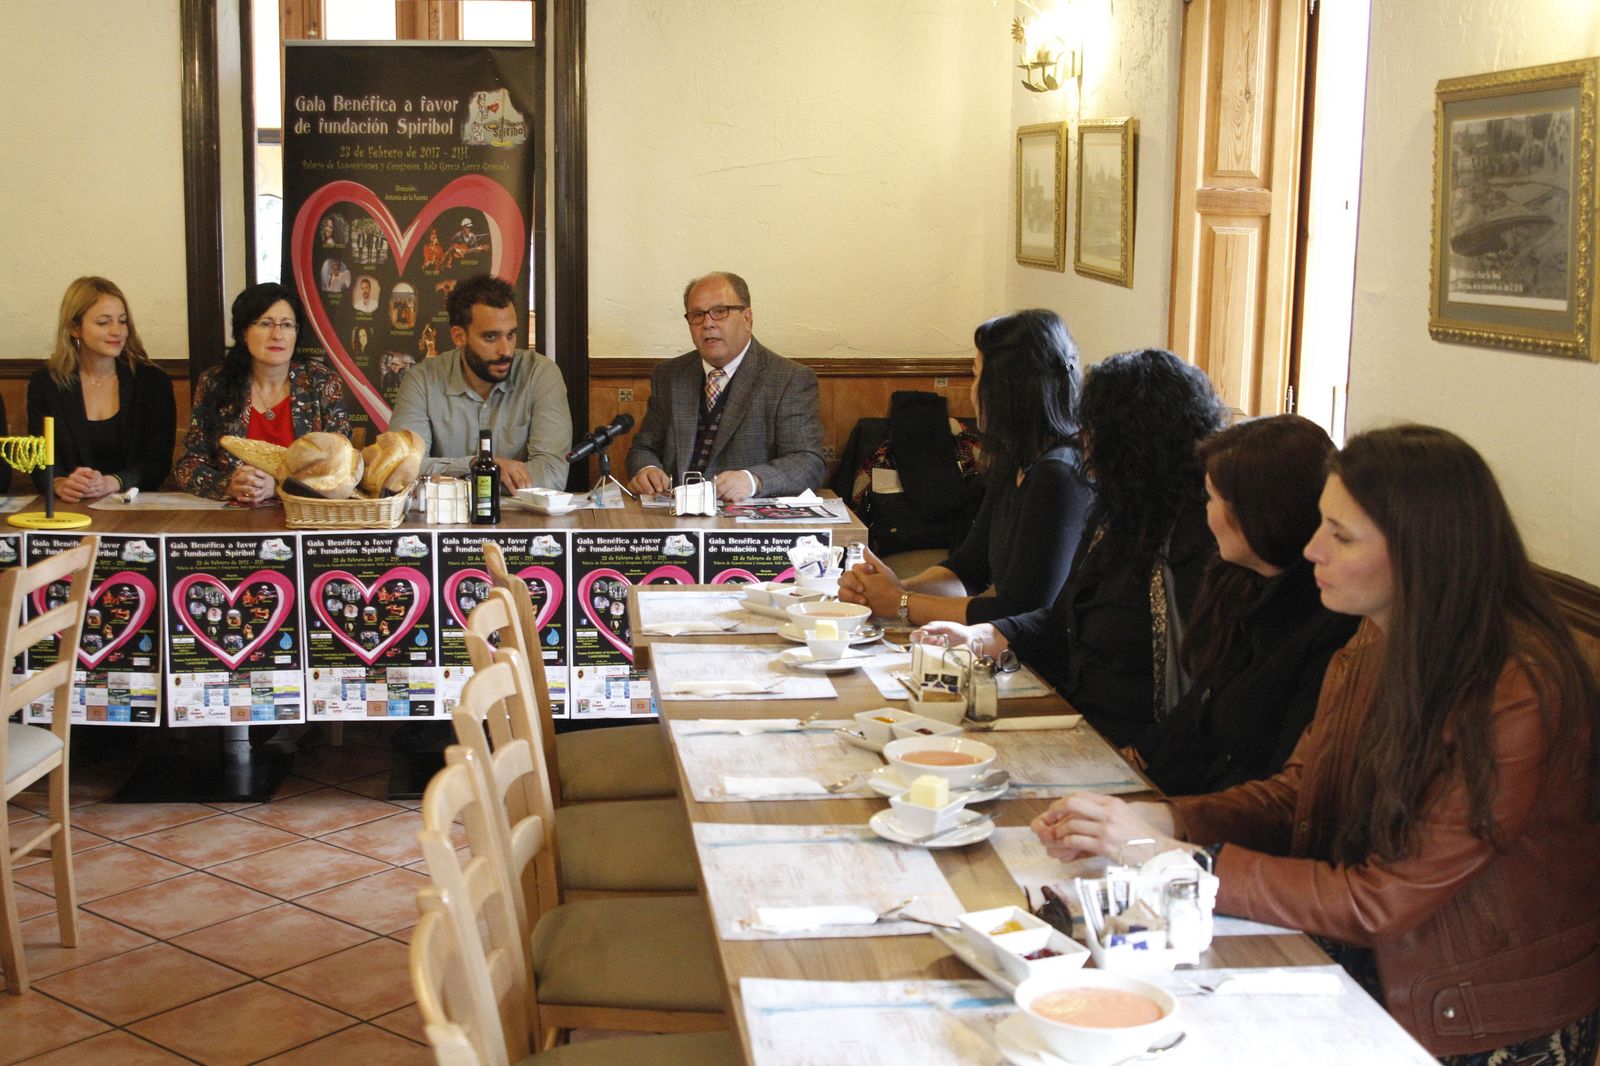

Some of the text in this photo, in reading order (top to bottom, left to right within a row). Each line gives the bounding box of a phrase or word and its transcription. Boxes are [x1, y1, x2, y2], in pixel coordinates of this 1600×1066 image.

[295, 95, 459, 112] Gala Benéfica a favor
[294, 118, 453, 138] de fundación Spiribol
[354, 145, 365, 158] de
[406, 146, 417, 158] de
[420, 147, 441, 158] 2017
[191, 541, 225, 549] Benéfica
[455, 545, 484, 553] fundaci
[170, 550, 180, 558] de
